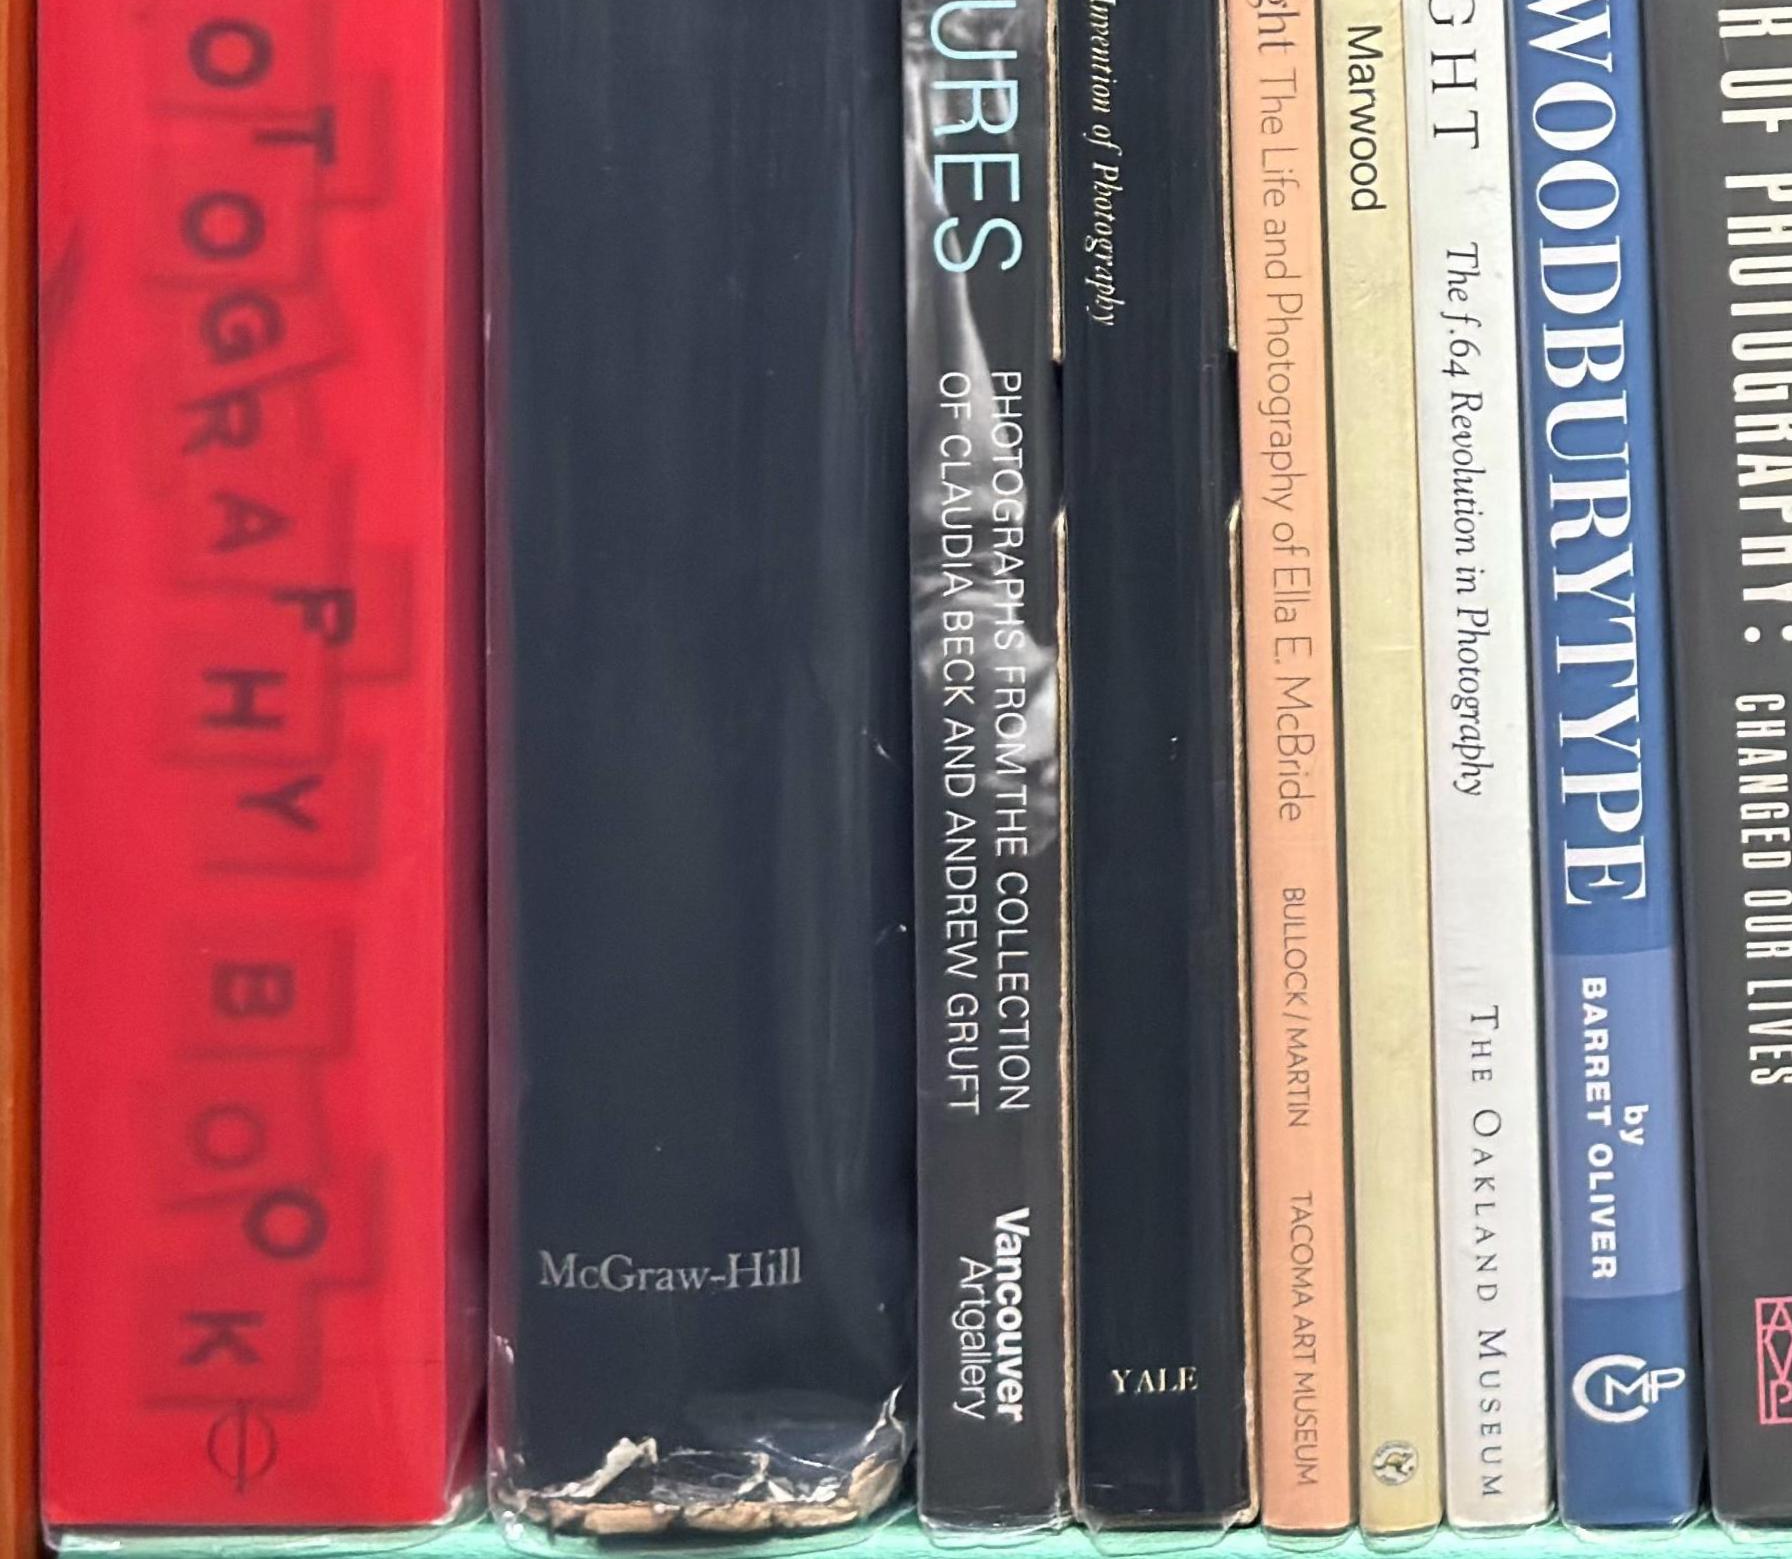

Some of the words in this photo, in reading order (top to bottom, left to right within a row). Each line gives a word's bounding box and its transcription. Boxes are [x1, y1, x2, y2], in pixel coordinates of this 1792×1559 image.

[1346, 24, 1386, 211] Marwood
[991, 372, 1025, 649] PHOTOGRAPHS
[994, 664, 1028, 775] FROM
[1735, 692, 1792, 872] CHANGED
[994, 792, 1028, 856] THE
[994, 873, 1031, 1110] COLLECTION
[1582, 978, 1612, 1126] BARRET
[178, 957, 330, 1368] BOOK
[1621, 1103, 1649, 1146] by
[539, 1248, 802, 1292] McGraw-Hill
[1289, 1192, 1314, 1308] TACOMA
[1588, 1143, 1616, 1279] OLIVER
[952, 1257, 986, 1420] Artgallery
[994, 1208, 1030, 1422] Vancouver
[1110, 1366, 1199, 1394] YALE
[1292, 1315, 1315, 1365] ART
[1292, 1372, 1319, 1485] MUSEUM
